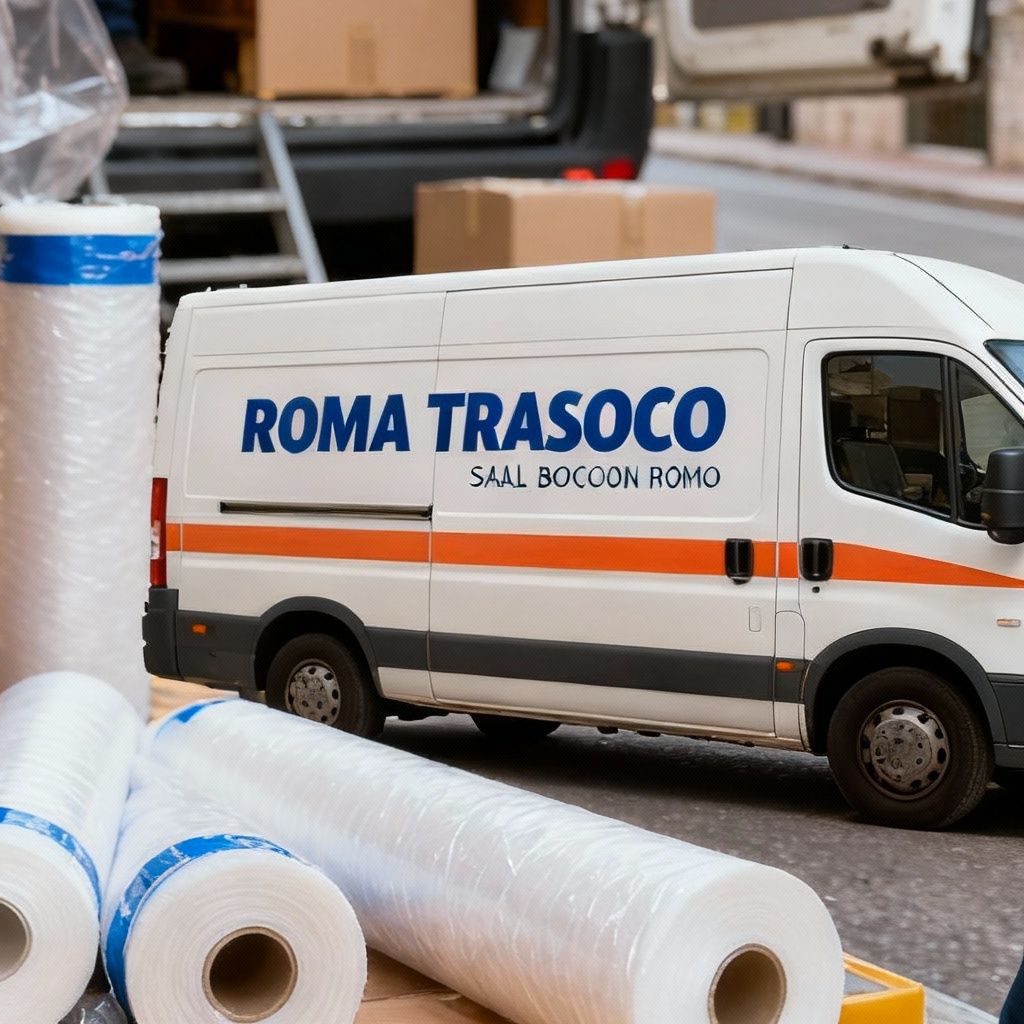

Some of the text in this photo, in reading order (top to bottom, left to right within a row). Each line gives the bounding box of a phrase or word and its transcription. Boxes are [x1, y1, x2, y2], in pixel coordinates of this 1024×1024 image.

[241, 386, 726, 454] ROMA TRASOCO
[537, 464, 639, 489] BOCOON
[649, 465, 721, 490] ROMO
